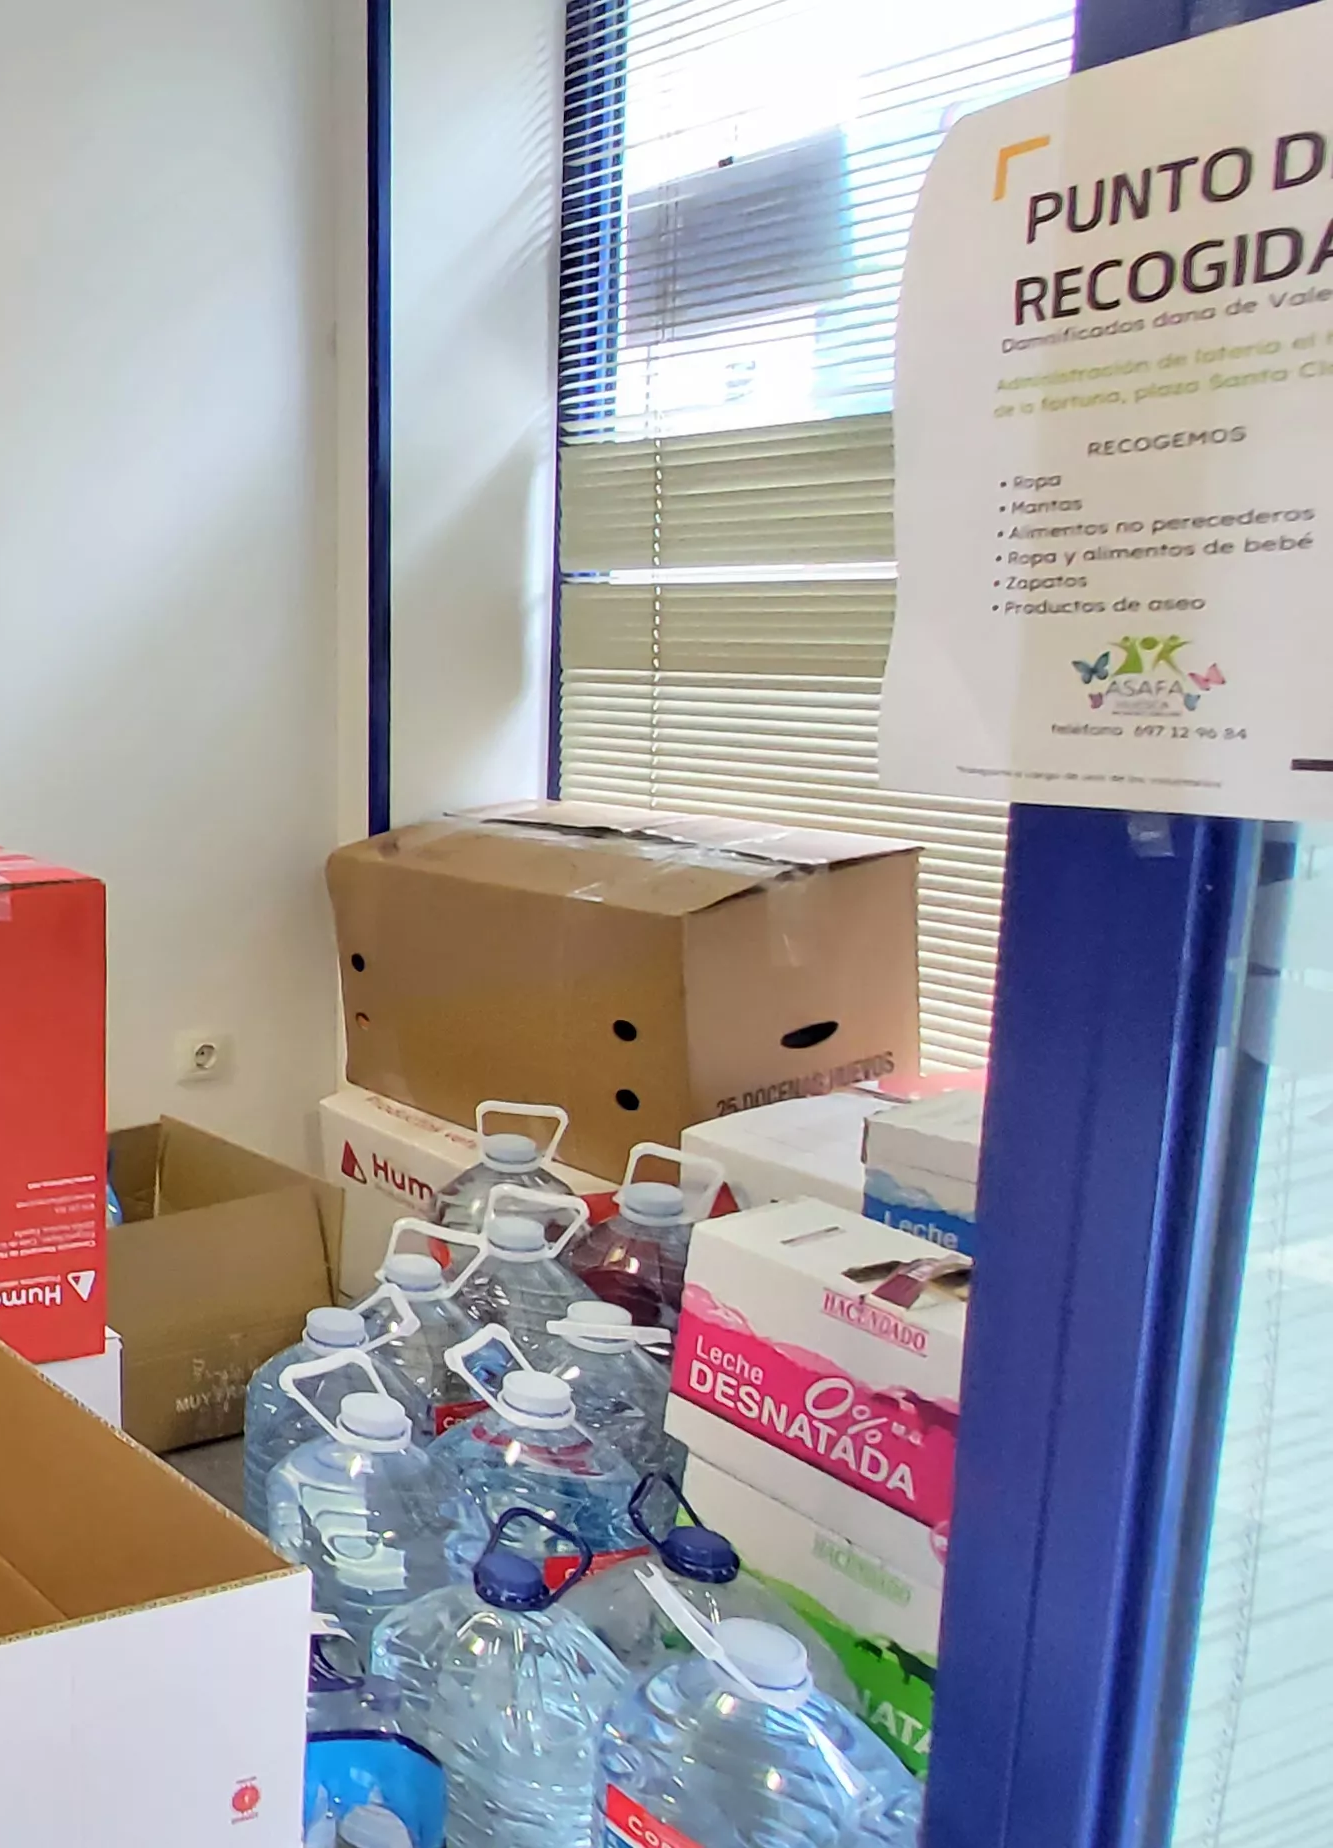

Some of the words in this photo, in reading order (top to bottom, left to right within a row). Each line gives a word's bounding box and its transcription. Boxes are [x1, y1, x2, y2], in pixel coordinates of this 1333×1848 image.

[1026, 147, 1253, 244] PUNTO
[1273, 131, 1333, 191] D
[1001, 318, 1144, 353] Damnificados
[1152, 305, 1216, 328] dana
[1225, 299, 1257, 316] de
[1157, 351, 1186, 369] de
[994, 404, 1014, 418] de
[1134, 379, 1200, 404] plaza
[1209, 366, 1289, 391] Santa
[1087, 426, 1247, 458] RECOGEMOS
[1013, 475, 1062, 491] Ropa
[1011, 499, 1083, 515] Mantas
[1008, 523, 1109, 540] Alimentos
[1116, 520, 1145, 534] no
[1152, 508, 1316, 536] perecederos
[1007, 551, 1057, 568] Ropa
[1063, 551, 1077, 567] y
[1083, 544, 1196, 561] alimentos
[1203, 539, 1235, 555] de
[1244, 531, 1314, 553] bebé
[1006, 576, 1088, 592] Zapatos
[1004, 600, 1107, 616] Productos
[1112, 598, 1141, 613] de
[1148, 598, 1206, 612] aseo
[1106, 680, 1185, 696] ASAFA
[1171, 726, 1189, 739] 12
[823, 1292, 927, 1351] HACENDADO
[697, 1335, 764, 1385] Leche
[805, 1377, 889, 1445] 0%
[689, 1359, 917, 1501] DESNATADA
